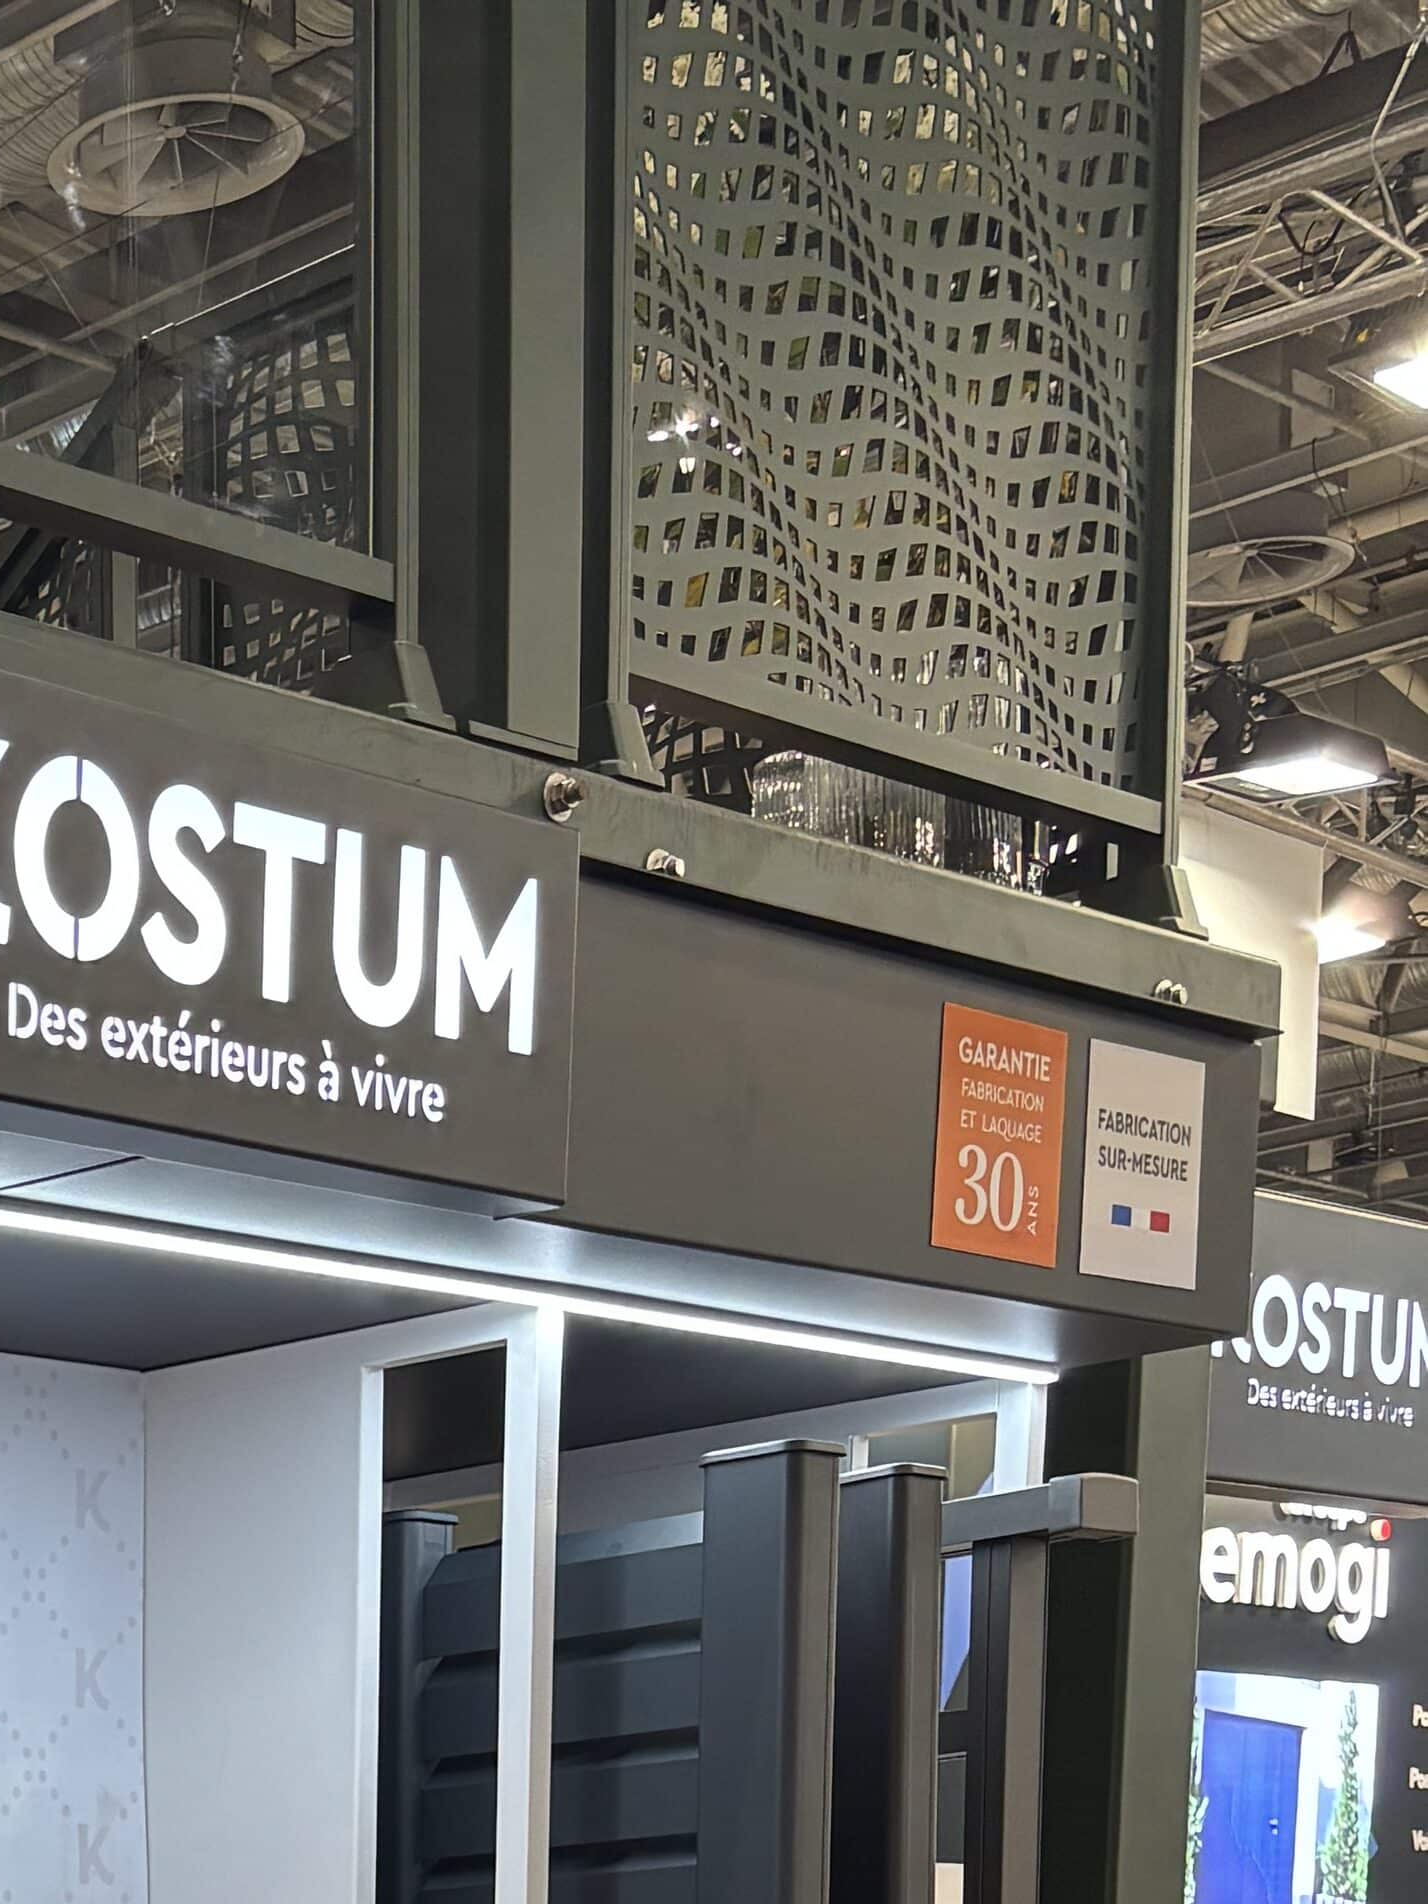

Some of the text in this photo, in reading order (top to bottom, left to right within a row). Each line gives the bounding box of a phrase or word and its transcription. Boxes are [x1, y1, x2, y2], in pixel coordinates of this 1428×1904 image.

[8, 982, 447, 1124] Des extérieurs à vivre
[958, 1036, 1052, 1083] GARANTIE
[960, 1077, 1044, 1113] FABRICATION
[960, 1110, 1043, 1145] ET LAQUAGE
[1097, 1107, 1192, 1147] FABRICATION
[955, 1144, 1039, 1237] 30 ANS
[1098, 1145, 1189, 1183] SUR-MESURE
[1247, 1377, 1277, 1407] Des
[1281, 1384, 1359, 1421] extérieurs
[1377, 1397, 1414, 1427] vivre
[75, 1468, 110, 1533] K
[1199, 1519, 1391, 1644] emogi
[75, 1648, 109, 1710] K
[78, 1823, 115, 1885] K
